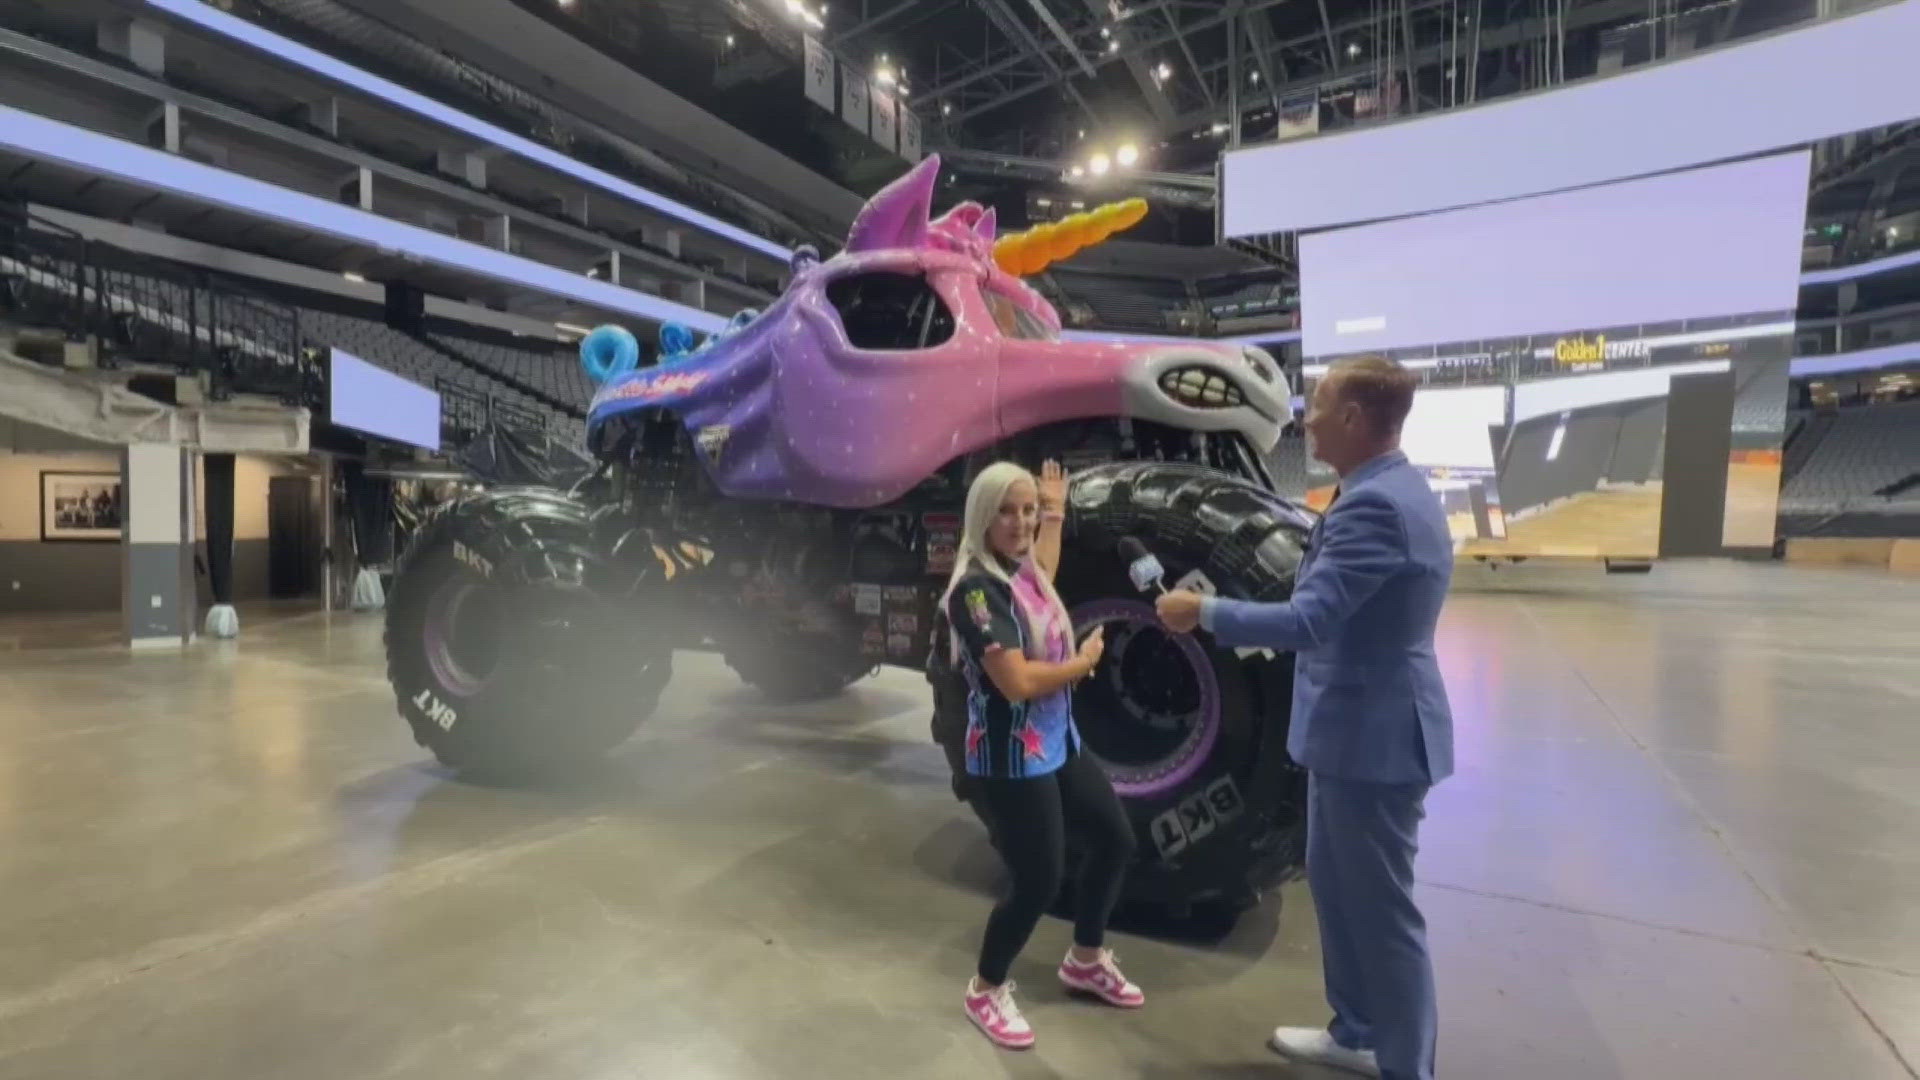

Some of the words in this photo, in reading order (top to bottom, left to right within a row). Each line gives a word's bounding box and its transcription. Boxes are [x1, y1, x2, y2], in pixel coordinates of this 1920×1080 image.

[453, 540, 493, 579] BKT
[412, 688, 457, 731] BKT
[1153, 776, 1242, 858] BKT
